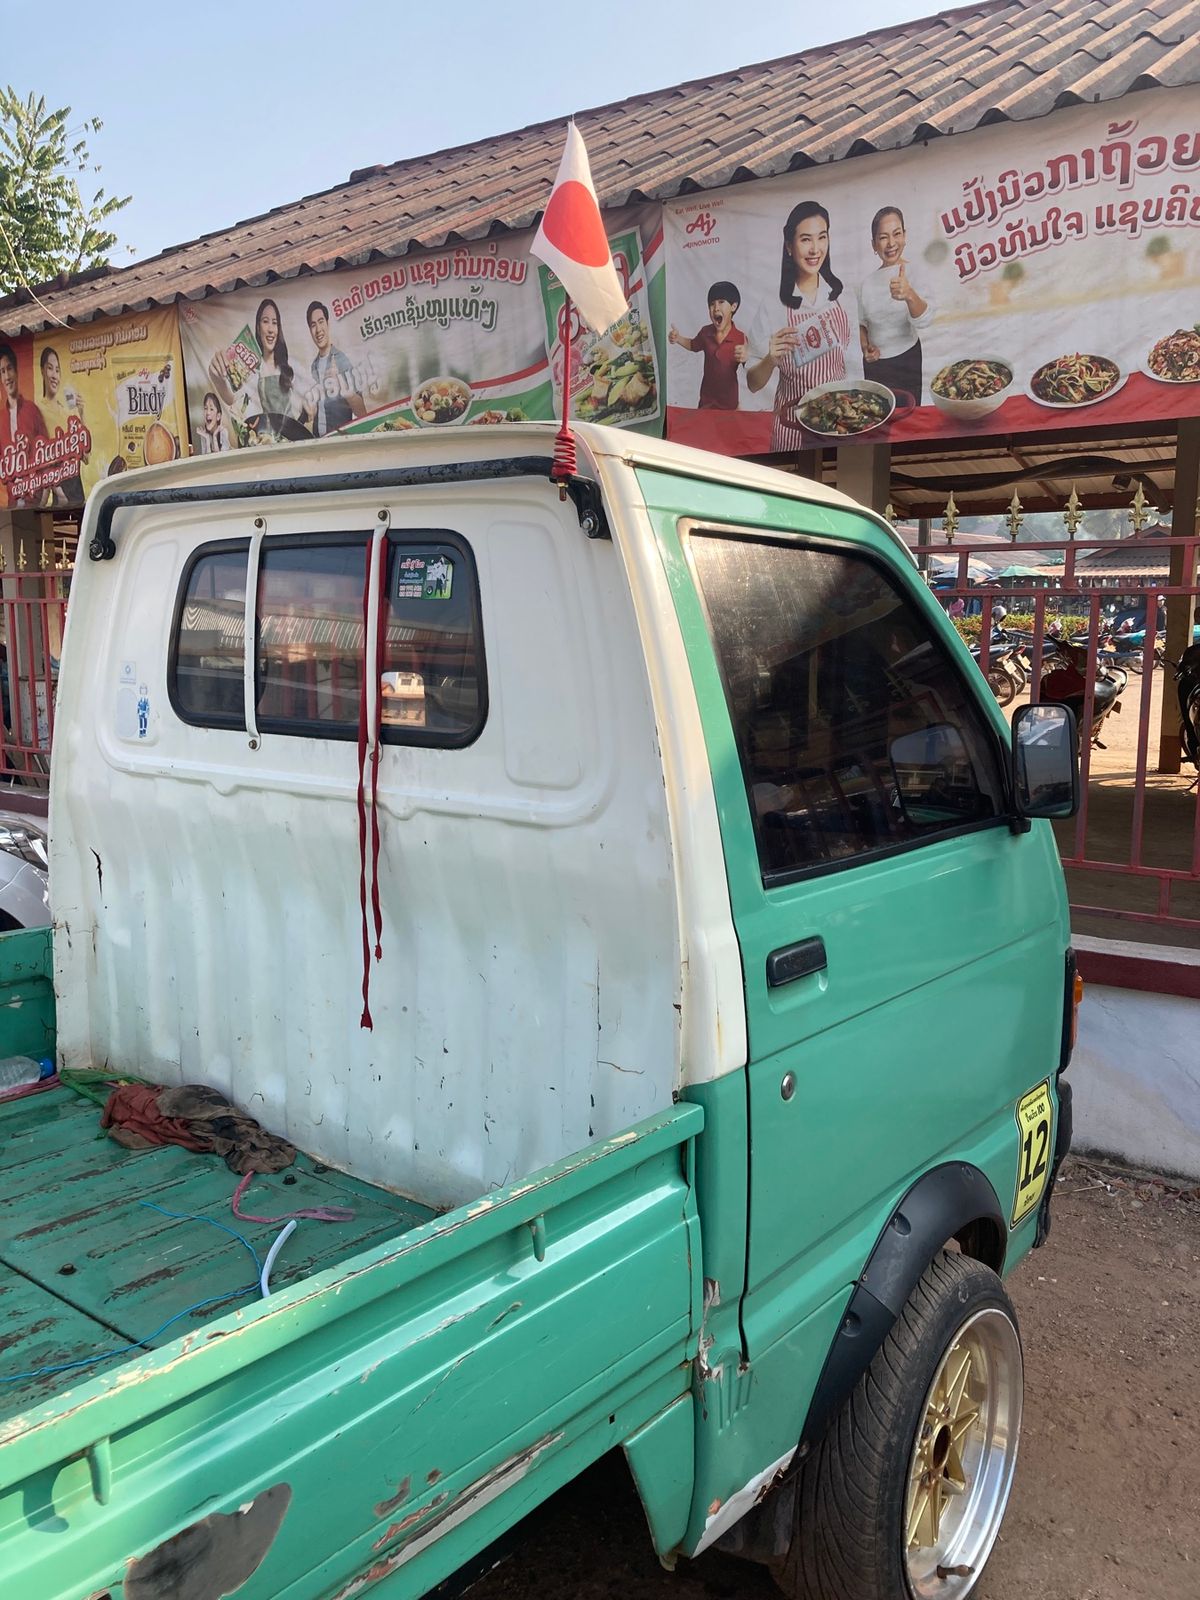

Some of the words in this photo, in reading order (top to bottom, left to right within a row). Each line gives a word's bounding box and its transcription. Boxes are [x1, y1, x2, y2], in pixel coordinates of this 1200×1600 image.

[682, 236, 720, 249] AJINOMOTO
[686, 212, 717, 236] Aj
[954, 207, 1083, 279] ນົວທັນໃຈ
[365, 268, 406, 298] ຫອມ
[410, 257, 450, 285] ແຊບ
[126, 386, 165, 420] Birdy
[1019, 1119, 1049, 1192] 12
